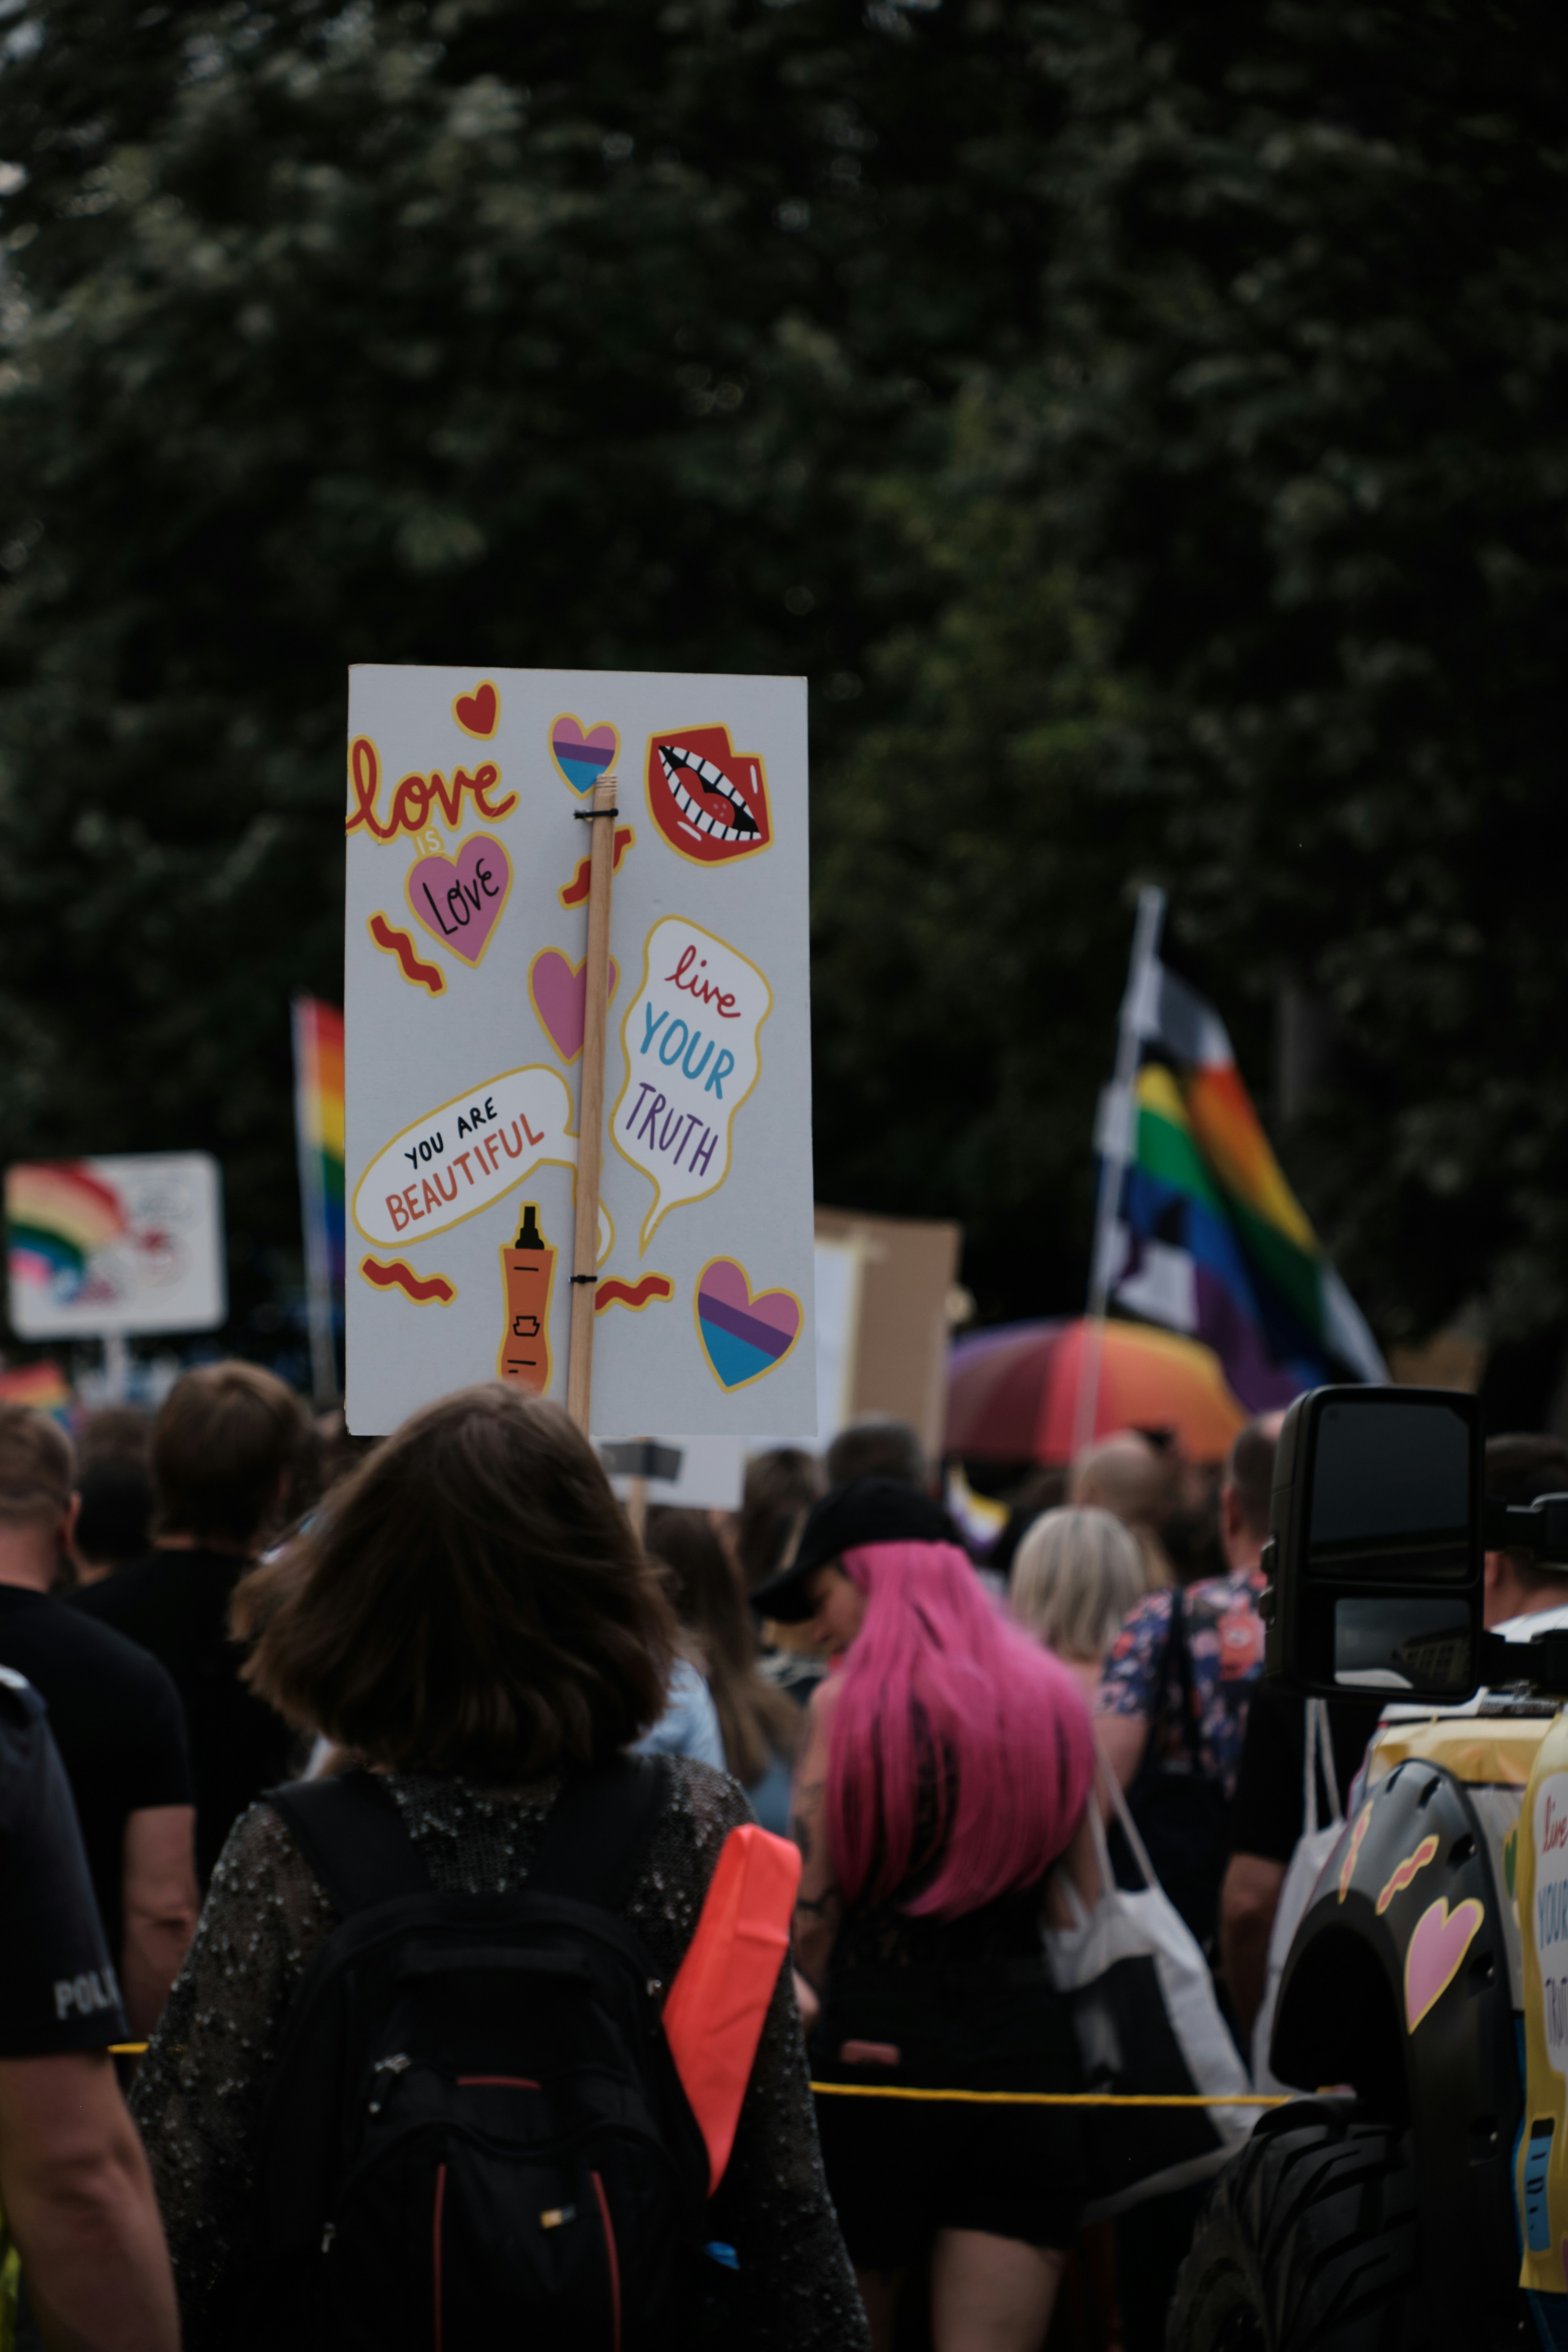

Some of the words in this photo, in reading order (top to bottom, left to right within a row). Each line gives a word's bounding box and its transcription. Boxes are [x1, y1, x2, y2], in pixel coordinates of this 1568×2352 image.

[345, 739, 516, 839] love
[416, 830, 440, 855] IS
[664, 945, 741, 1018] live
[640, 1001, 735, 1100] YOUR
[385, 1113, 545, 1232] BEAUTIFUL
[405, 1132, 444, 1170] YOU
[457, 1097, 498, 1138] ARE
[626, 1082, 719, 1177] TRUTH
